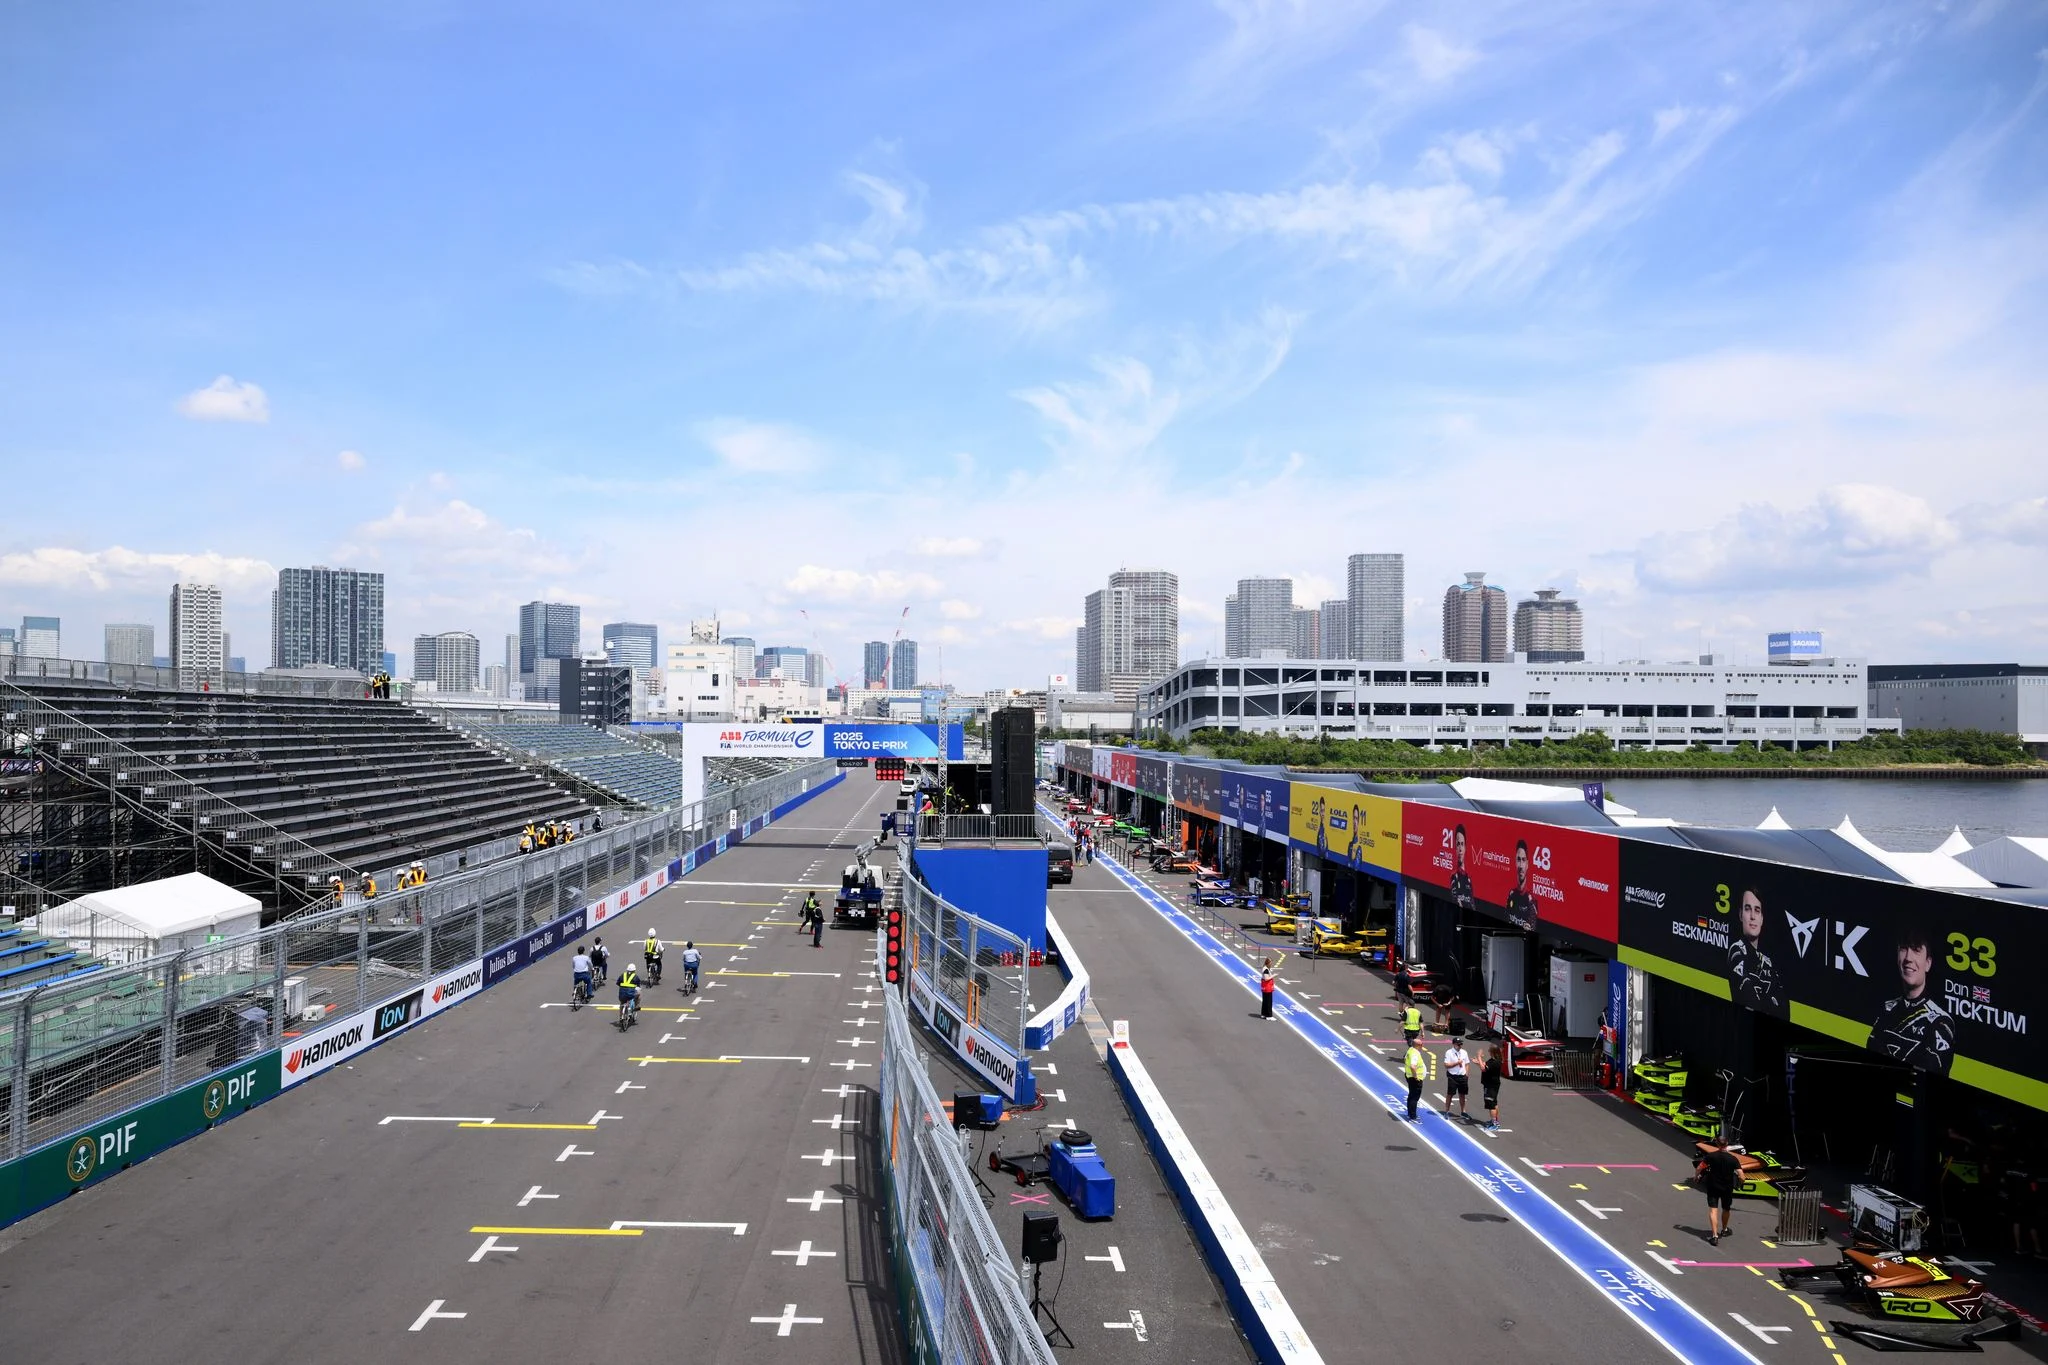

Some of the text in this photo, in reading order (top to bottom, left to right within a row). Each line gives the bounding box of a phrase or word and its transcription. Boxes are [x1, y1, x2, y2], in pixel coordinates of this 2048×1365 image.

[720, 731, 742, 741] ABB
[742, 730, 796, 742] FORMULA
[833, 732, 863, 741] 2025
[833, 741, 908, 750] TOKYO E-PRIX
[1312, 801, 1319, 816] 22
[1330, 808, 1348, 818] LOLA
[1360, 810, 1367, 827] 11
[1442, 828, 1453, 849] 21
[1433, 855, 1453, 870] DE VRIES
[1483, 851, 1510, 865] mahindra
[1532, 846, 1551, 870] 48
[640, 880, 649, 897] ABB
[1532, 883, 1564, 902] MORTARA
[1634, 887, 1658, 901] FORMULA
[619, 890, 629, 909] ABB
[1715, 883, 1730, 914] 3
[595, 902, 606, 922] ABB
[1672, 921, 1729, 950] BECKMANN
[1709, 918, 1729, 934] David
[529, 932, 554, 958] Julius Bär
[1945, 932, 1997, 977] 33
[489, 949, 518, 974] Julius Bär
[1944, 979, 1969, 998] Dan
[1944, 994, 2027, 1035] TICKTUM
[227, 1069, 257, 1105] PIF
[100, 1121, 138, 1165] PIF
[1874, 1214, 1894, 1235] BOOST
[1891, 1255, 1904, 1265] 33
